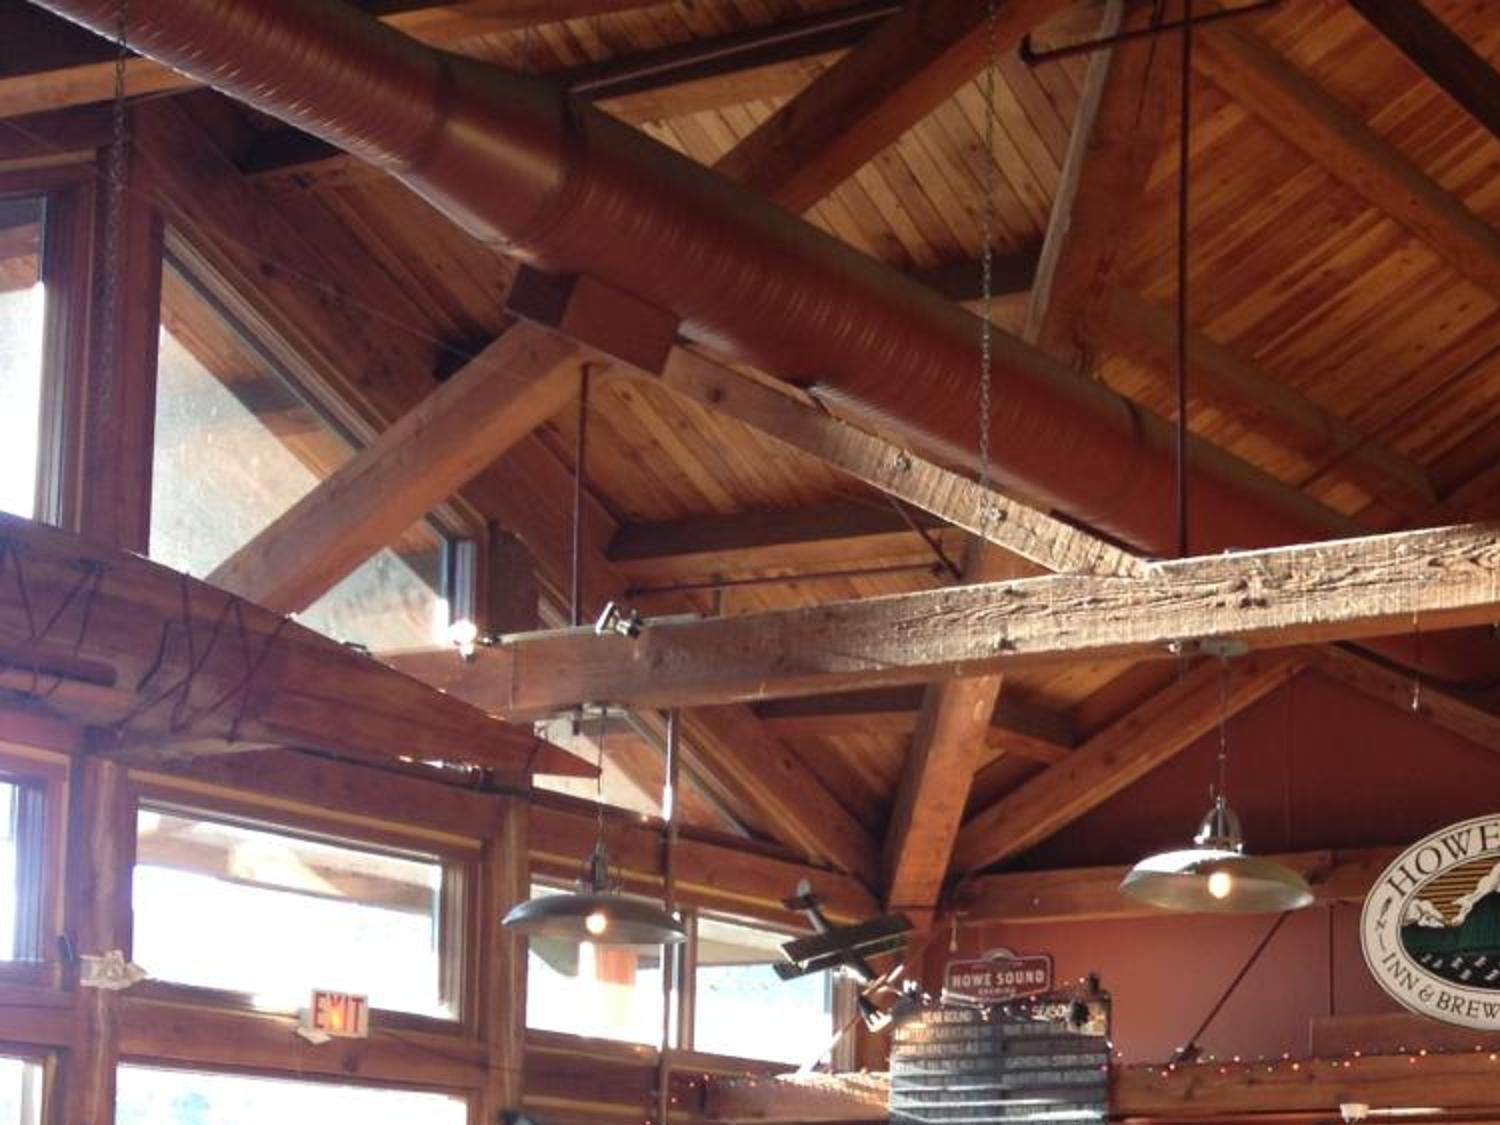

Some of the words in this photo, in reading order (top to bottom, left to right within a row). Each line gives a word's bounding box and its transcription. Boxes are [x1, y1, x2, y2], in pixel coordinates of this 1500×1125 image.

[1387, 821, 1500, 897] HOWE
[952, 973, 992, 987] HOWE
[996, 969, 1045, 986] SOUND
[1381, 952, 1417, 991] INN
[1418, 988, 1435, 1006] &
[313, 991, 365, 1033] EXIT
